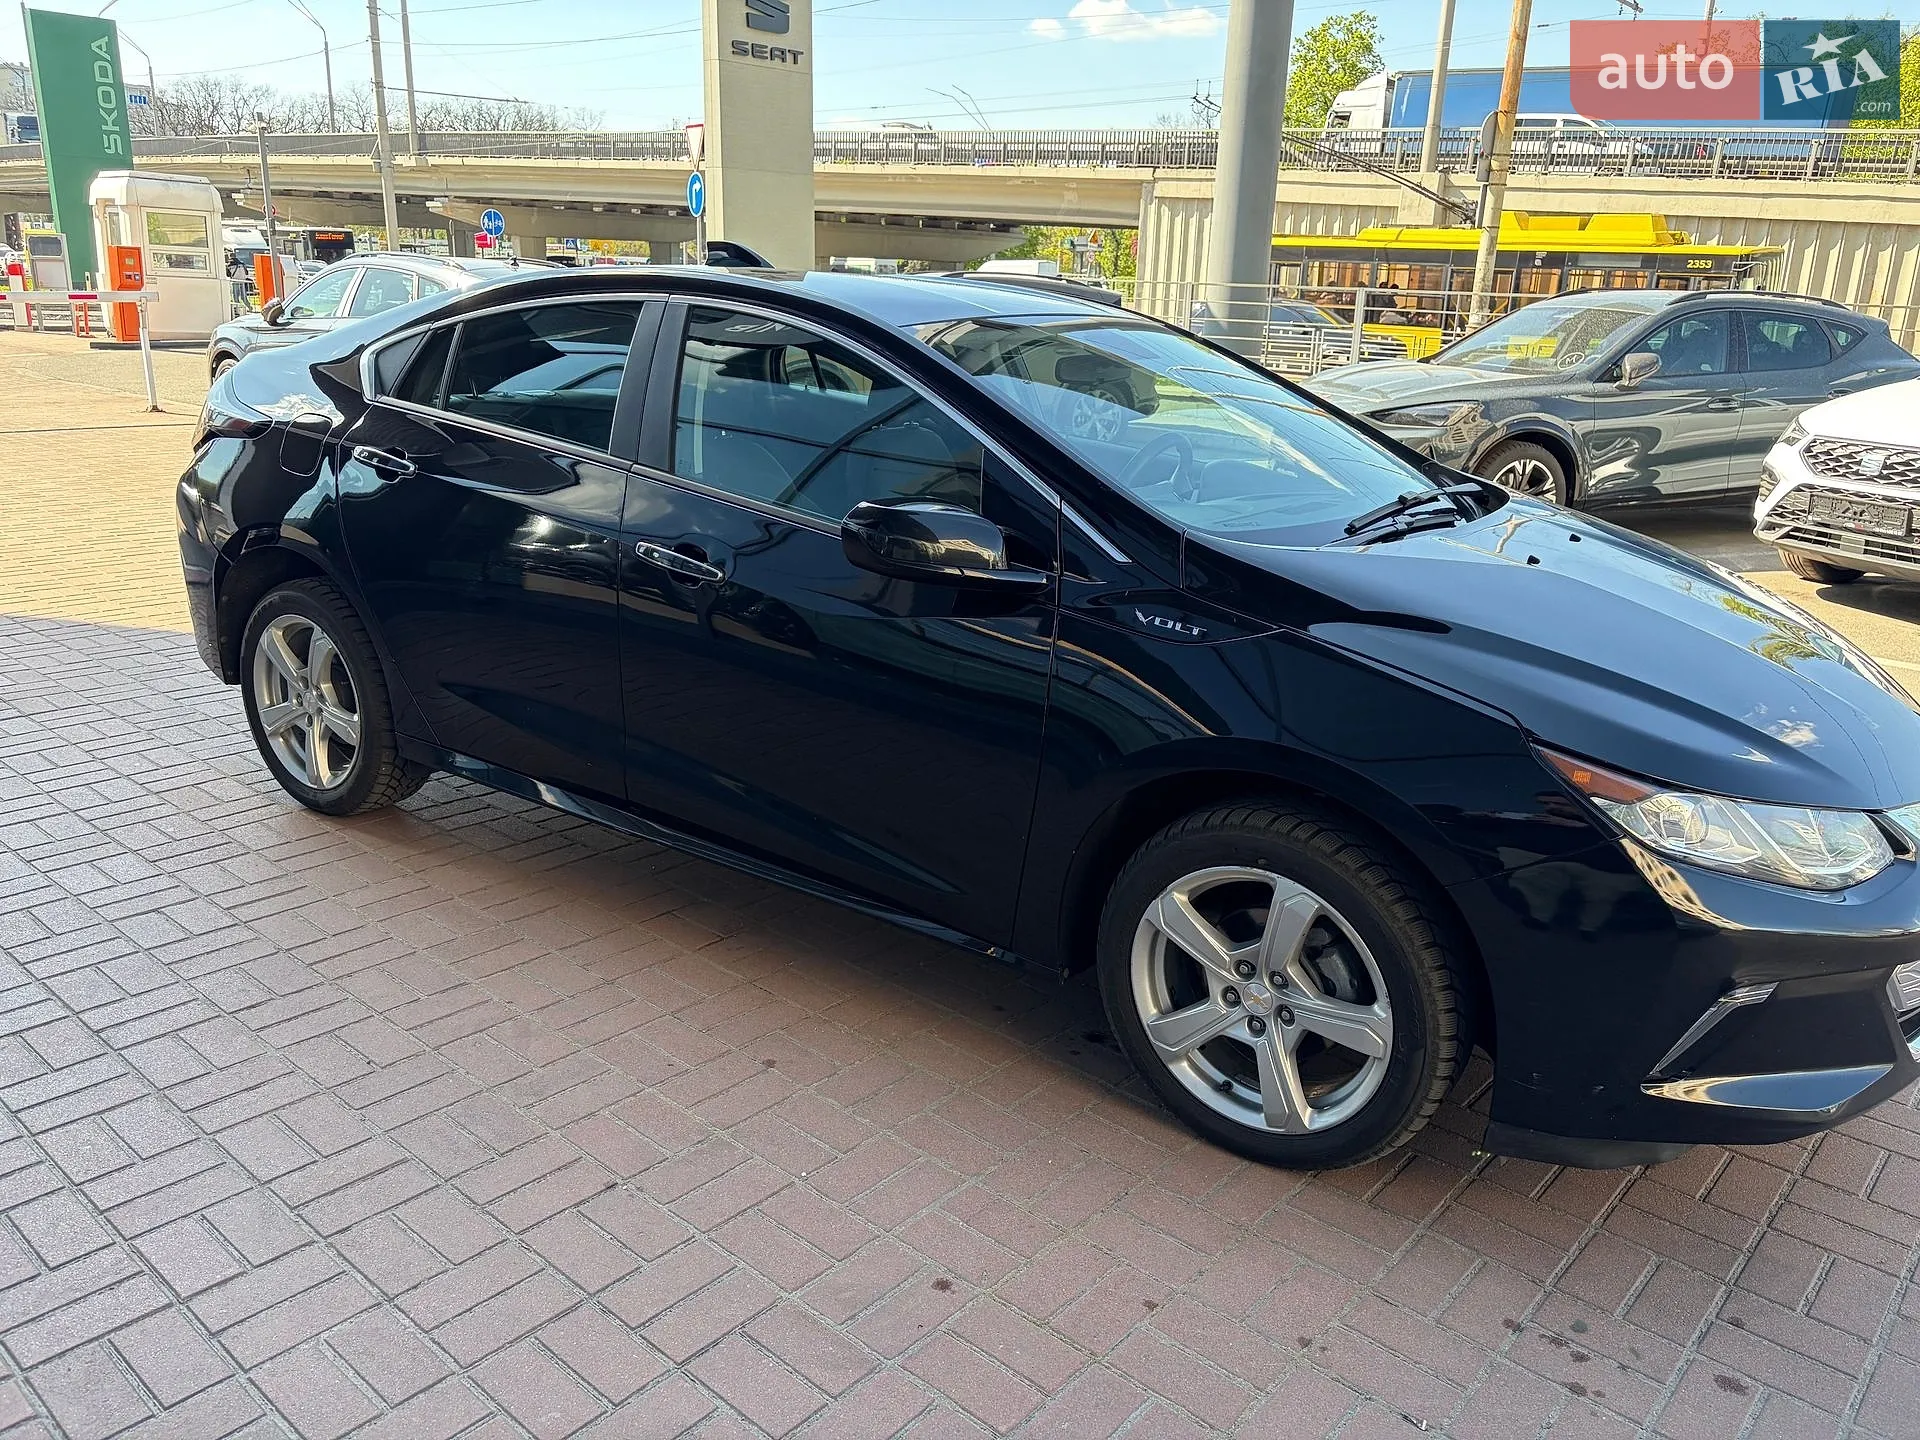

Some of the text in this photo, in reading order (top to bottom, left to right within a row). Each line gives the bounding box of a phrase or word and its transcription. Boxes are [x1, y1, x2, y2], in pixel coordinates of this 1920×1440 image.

[731, 39, 804, 65] SEAT
[1686, 259, 1713, 269] 2353
[1134, 607, 1208, 636] VOLT
